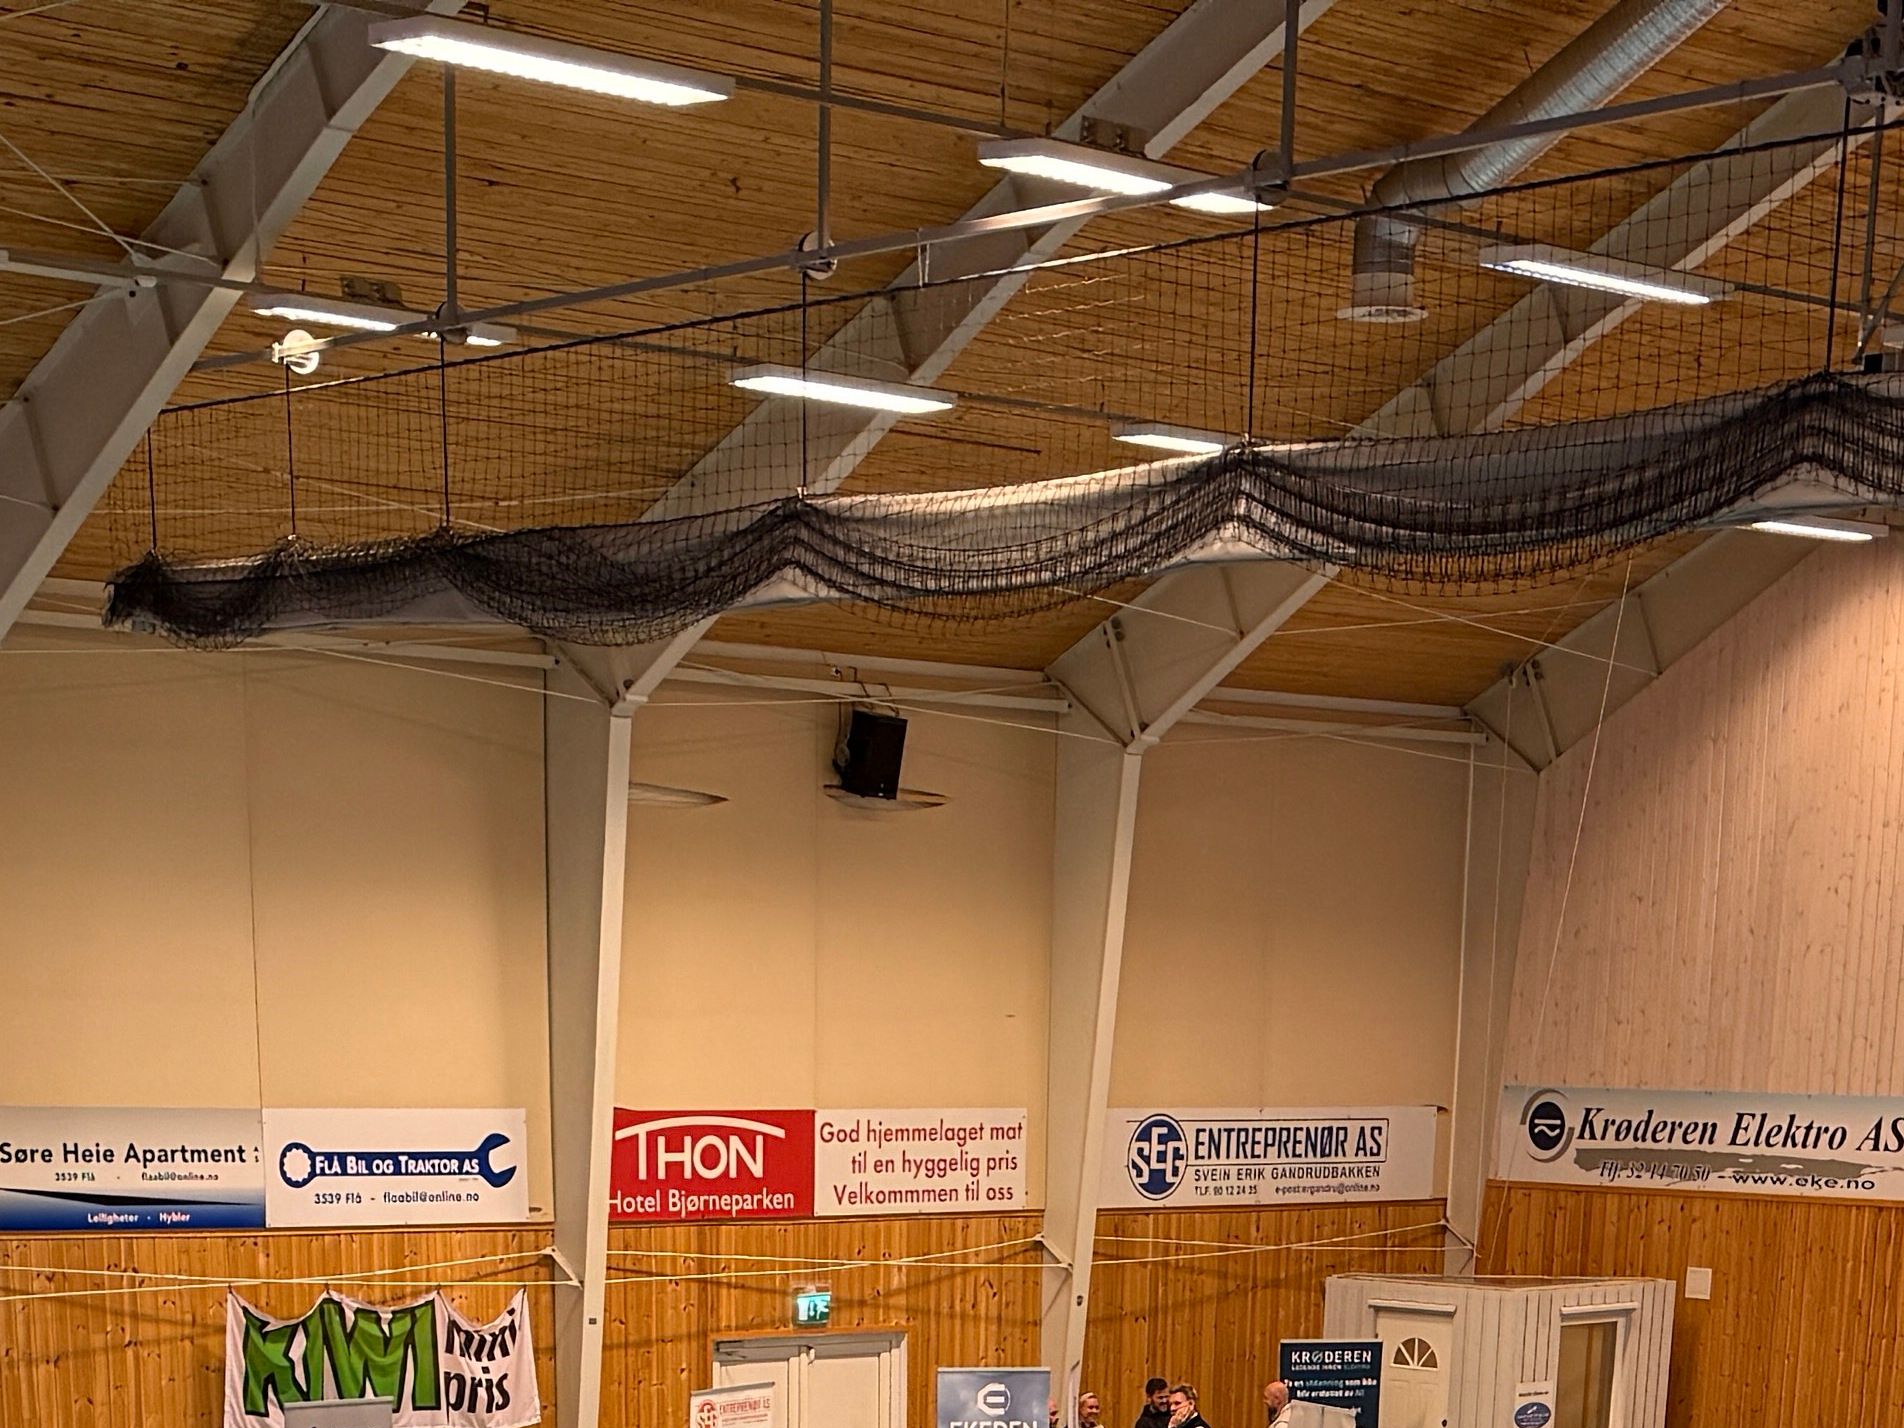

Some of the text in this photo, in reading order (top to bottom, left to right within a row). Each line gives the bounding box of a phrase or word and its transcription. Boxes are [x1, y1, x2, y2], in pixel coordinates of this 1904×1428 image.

[820, 1121, 1023, 1148] God hjemmelaget mat
[1194, 1125, 1383, 1161] ENTREPRENØR AS
[1577, 1108, 1717, 1146] Krøderen
[1728, 1113, 1847, 1150] Elektro
[0, 1143, 246, 1168] Søre Heie Apartment
[615, 1116, 786, 1180] THON
[1131, 1126, 1184, 1184] SEG
[373, 1159, 394, 1175] OG
[399, 1155, 458, 1174] TRAKTOR
[462, 1158, 479, 1173] AS
[852, 1151, 1018, 1179] til en hyggelig pris
[1194, 1165, 1381, 1182] SVEIN ERIK GANDRUDBAKKEN
[965, 1184, 980, 1203] til
[986, 1187, 1014, 1201] oss
[1733, 1171, 1876, 1191] www.eke.no
[314, 1193, 342, 1205] 3539
[609, 1188, 795, 1219] Hotel Bjørneparken
[446, 1308, 518, 1361] mini
[243, 1297, 440, 1417] KIWI
[1291, 1350, 1371, 1363] KRØDEREN
[445, 1366, 511, 1414] pris
